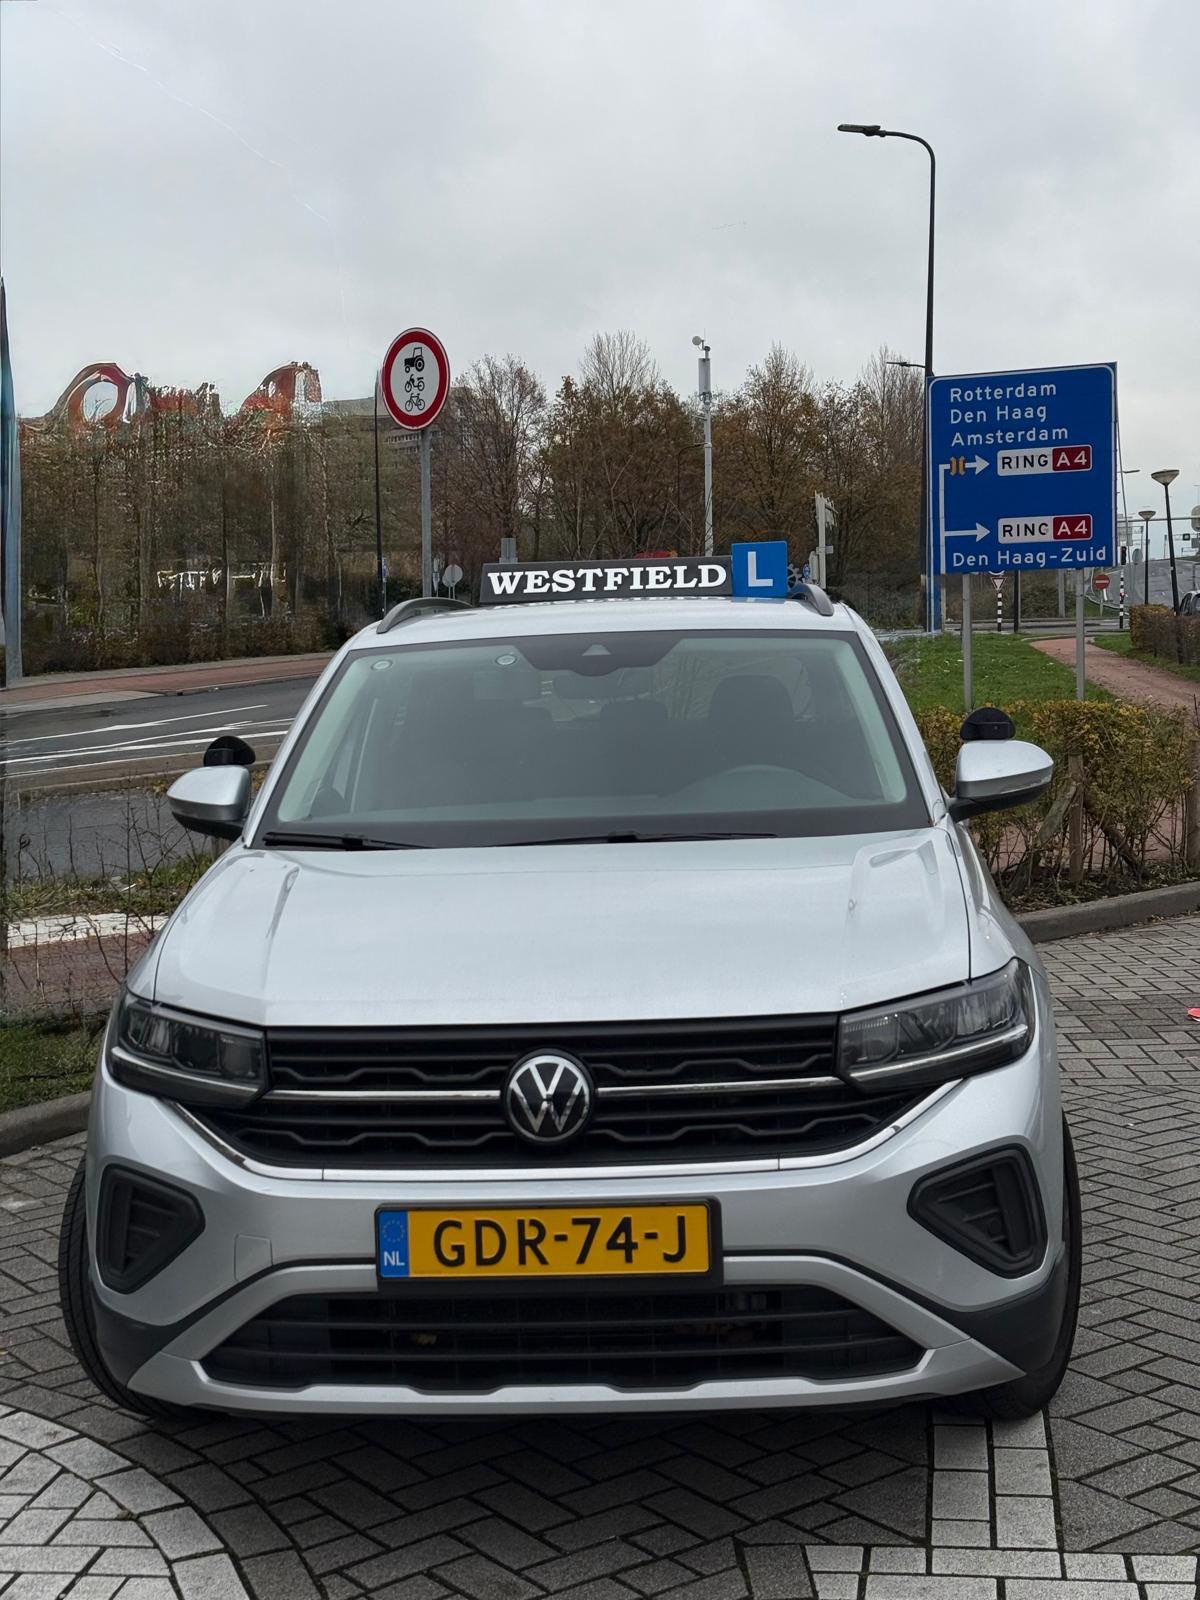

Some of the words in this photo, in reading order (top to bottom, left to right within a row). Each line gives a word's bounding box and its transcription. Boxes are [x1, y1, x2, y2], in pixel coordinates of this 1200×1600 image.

[950, 382, 1057, 403] Rotterdam
[950, 408, 987, 425] Den
[996, 404, 1047, 422] Haag
[951, 425, 1069, 447] Amsterdam
[1001, 453, 1049, 470] RING
[1056, 450, 1087, 467] A4
[1002, 522, 1049, 538] RING
[1057, 519, 1088, 536] A4
[953, 551, 989, 567] Den
[997, 546, 1106, 568] Haag-Zuid
[487, 563, 727, 595] WESTFIELD
[747, 551, 774, 587] L
[433, 1215, 687, 1268] GDR-74-J
[383, 1251, 405, 1267] NL
